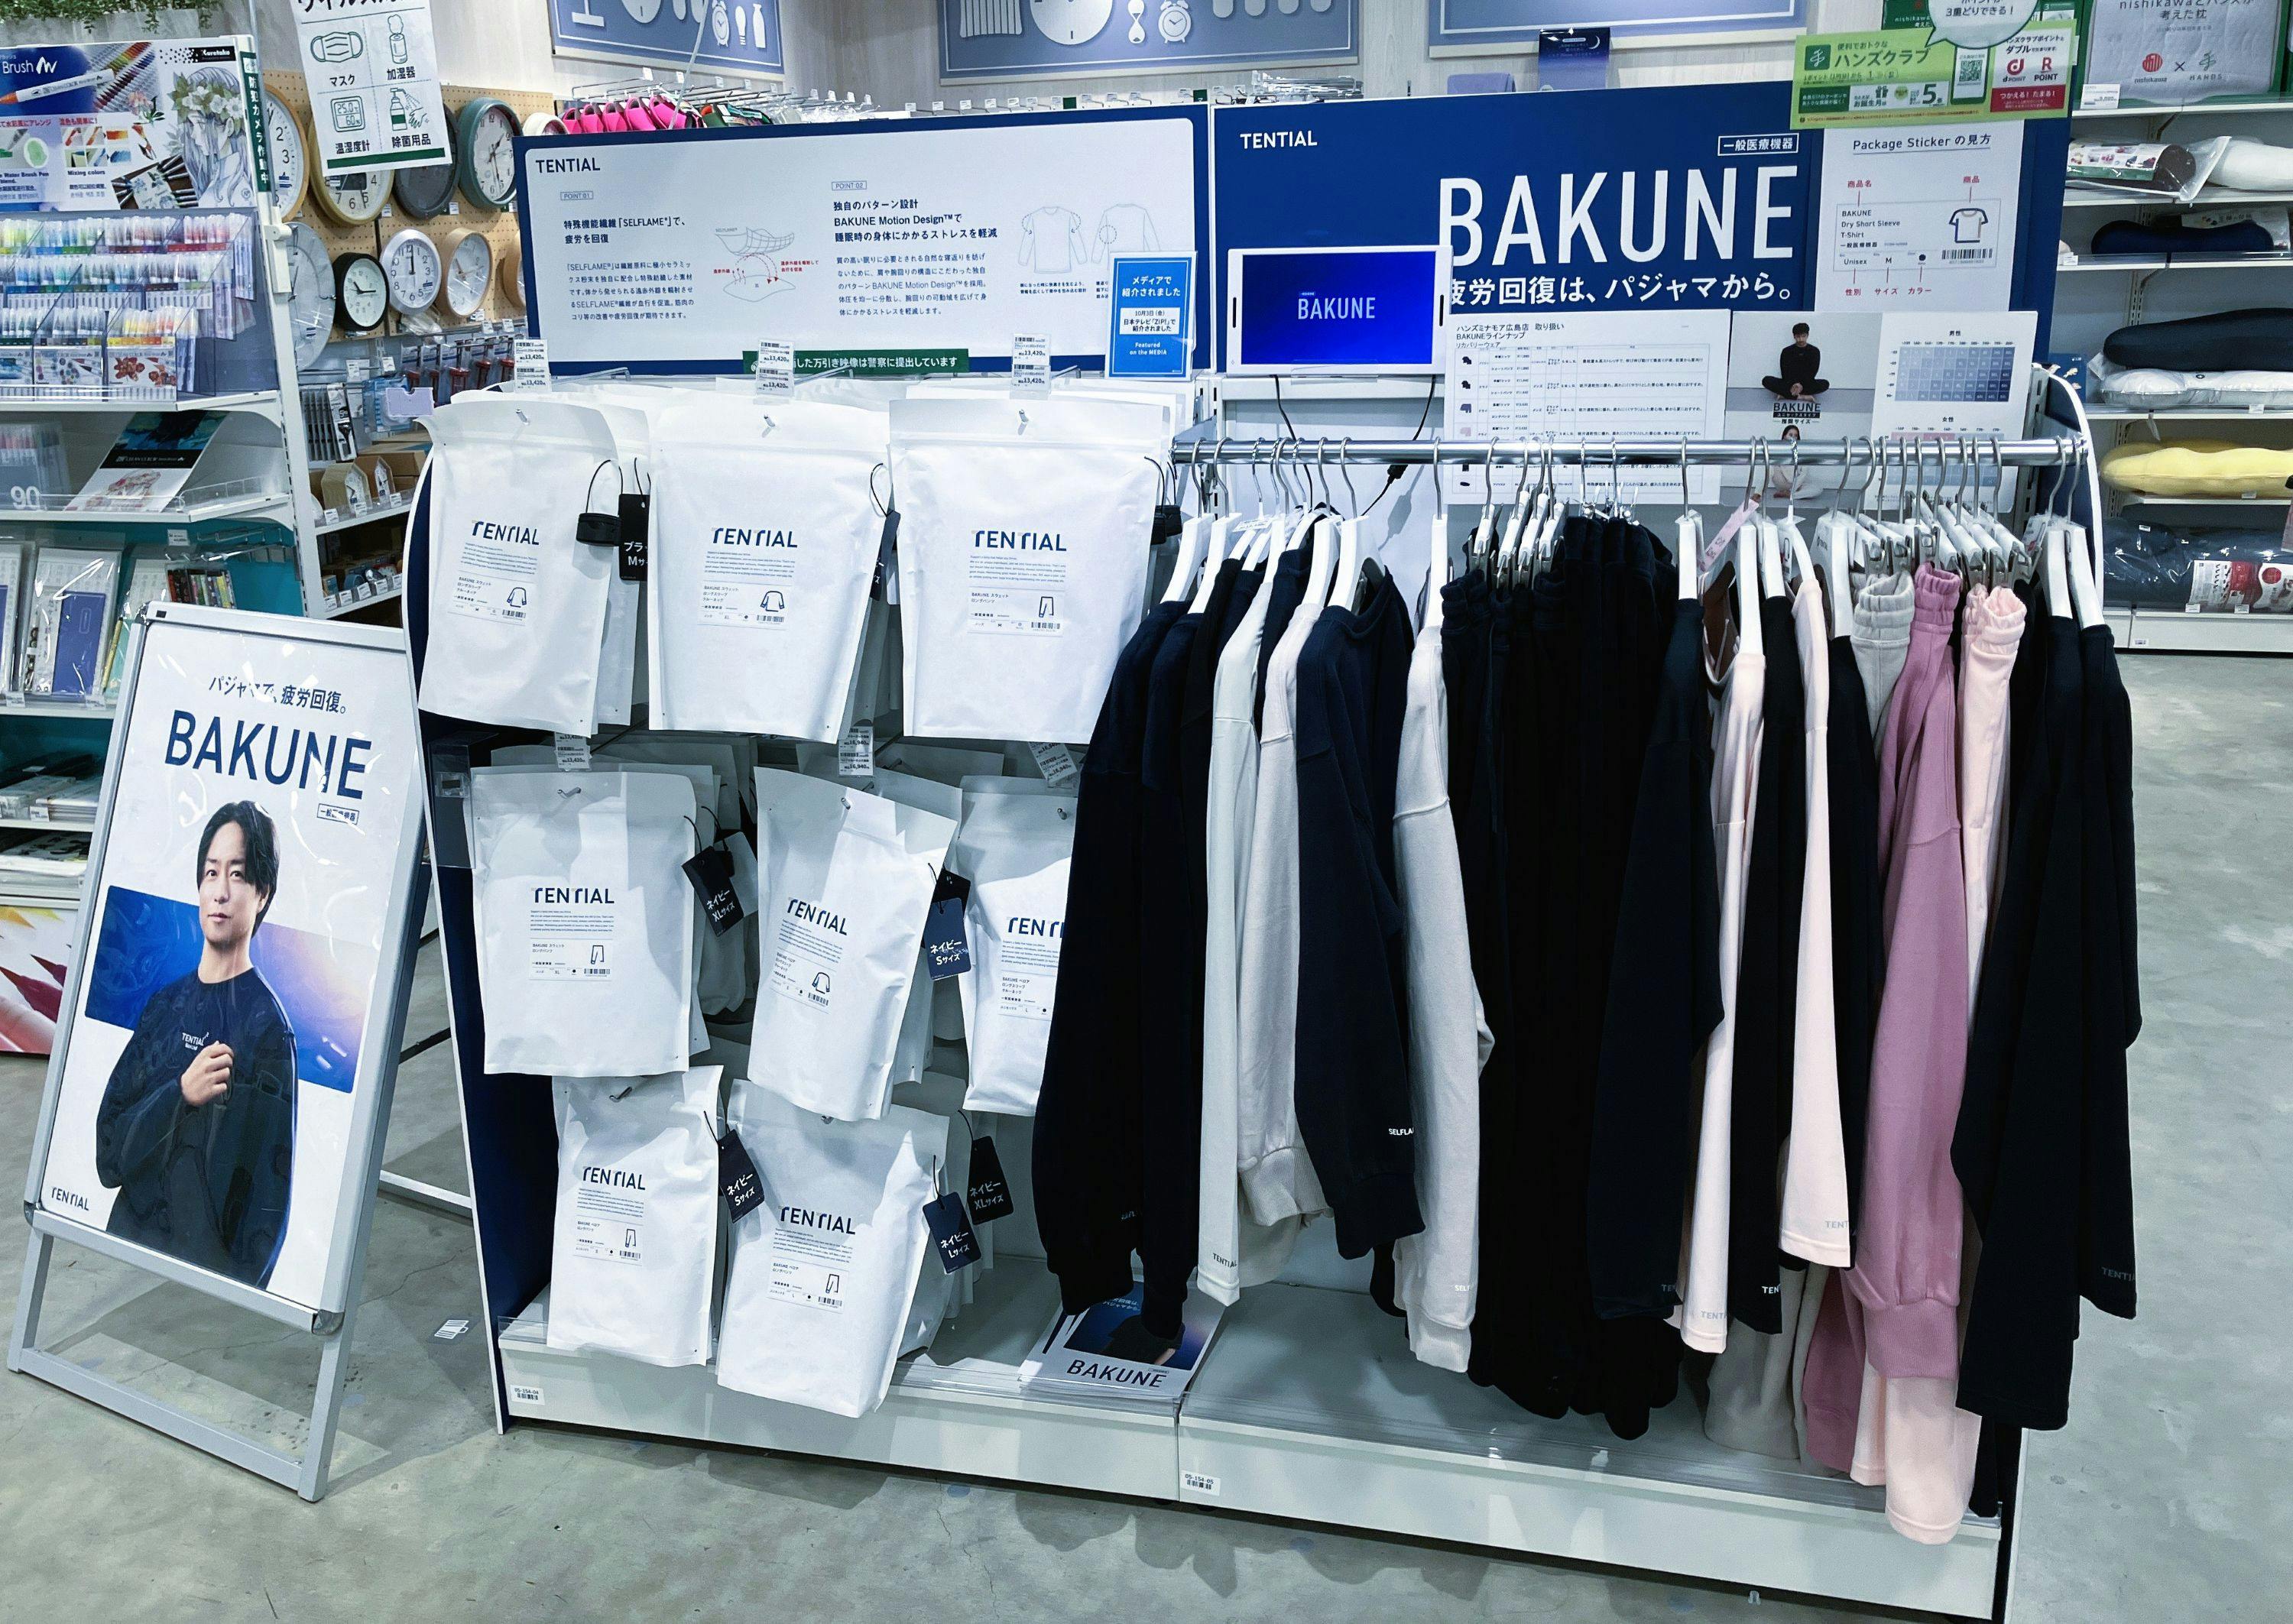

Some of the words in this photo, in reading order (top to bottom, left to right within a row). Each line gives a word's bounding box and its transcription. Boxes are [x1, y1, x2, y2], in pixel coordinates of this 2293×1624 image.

[2160, 9, 2207, 20] 考えた枕
[1837, 41, 1888, 51] 便利でおトクな
[1834, 48, 1931, 68] ハンズクラブ
[2, 60, 34, 75] Brush
[387, 66, 416, 81] 加湿器
[329, 74, 355, 86] マスク
[276, 126, 284, 141] 2
[392, 133, 432, 148] 除菌用品
[1240, 130, 1318, 149] TENTIAL
[335, 139, 371, 154] 温湿度計
[1723, 137, 1793, 151] 一般医療機器
[1854, 139, 1903, 151] Package
[1907, 136, 1951, 148] Sticker
[1954, 134, 1992, 145] の見方
[282, 149, 290, 164] 3
[535, 157, 601, 173] TENTIAL
[1847, 180, 1873, 188] 商品名
[1964, 175, 1980, 184] 商品
[833, 199, 919, 211] 独自のパターン設計
[834, 216, 876, 227] BAKUNE
[879, 215, 910, 225] Motion
[1439, 165, 1798, 267] BAKUNE
[1841, 221, 1854, 229] Dry
[565, 234, 609, 245] 疲労を回復
[835, 228, 998, 242] 睡眠時の身体にかかるストレスを軽減
[1132, 276, 1172, 285] メディアで
[1121, 287, 1182, 297] 紹介されました
[1845, 288, 1862, 297] 性別
[1874, 287, 1899, 296] サイズ
[1908, 287, 1932, 295] カラー
[1298, 297, 1376, 319] BAKUNE
[1457, 323, 1529, 332] ハンズミナモア広島店
[1535, 323, 1565, 331] 取り扱い
[1456, 332, 1526, 340] BAKUNEラインナップ
[793, 356, 958, 370] した万引き映像は警察に提出しています
[1773, 403, 1821, 413] BAKUNE
[10, 485, 41, 510] 90
[471, 520, 540, 546] TENTIAL
[711, 527, 798, 548] TENTIAL
[624, 541, 648, 553] ブラ
[971, 530, 1067, 552] TENTIAL
[628, 556, 648, 566] Mサ
[164, 709, 372, 800] BAKUNE
[530, 887, 615, 905] TENTIAL
[706, 890, 731, 911] ネイビー
[712, 902, 736, 922] XLサイズ
[786, 897, 848, 936] TENTIAL
[929, 939, 963, 955] ネイビー
[936, 953, 961, 966] Sサイズ
[182, 1032, 204, 1046] TENTIAL
[1388, 1127, 1415, 1136] SELFLA
[582, 1166, 646, 1191] TENTIAL
[726, 1173, 754, 1196] ネイビー
[735, 1186, 755, 1207] Sサイズ
[969, 1181, 1001, 1198] ネイビー
[50, 1186, 89, 1211] TENTIAL
[974, 1194, 1004, 1211] XLサイズ
[778, 1205, 856, 1236] TENTIAL
[940, 1231, 969, 1250] ネイビー
[948, 1243, 971, 1259] Lサイズ
[1066, 1360, 1166, 1388] BAKUNE
